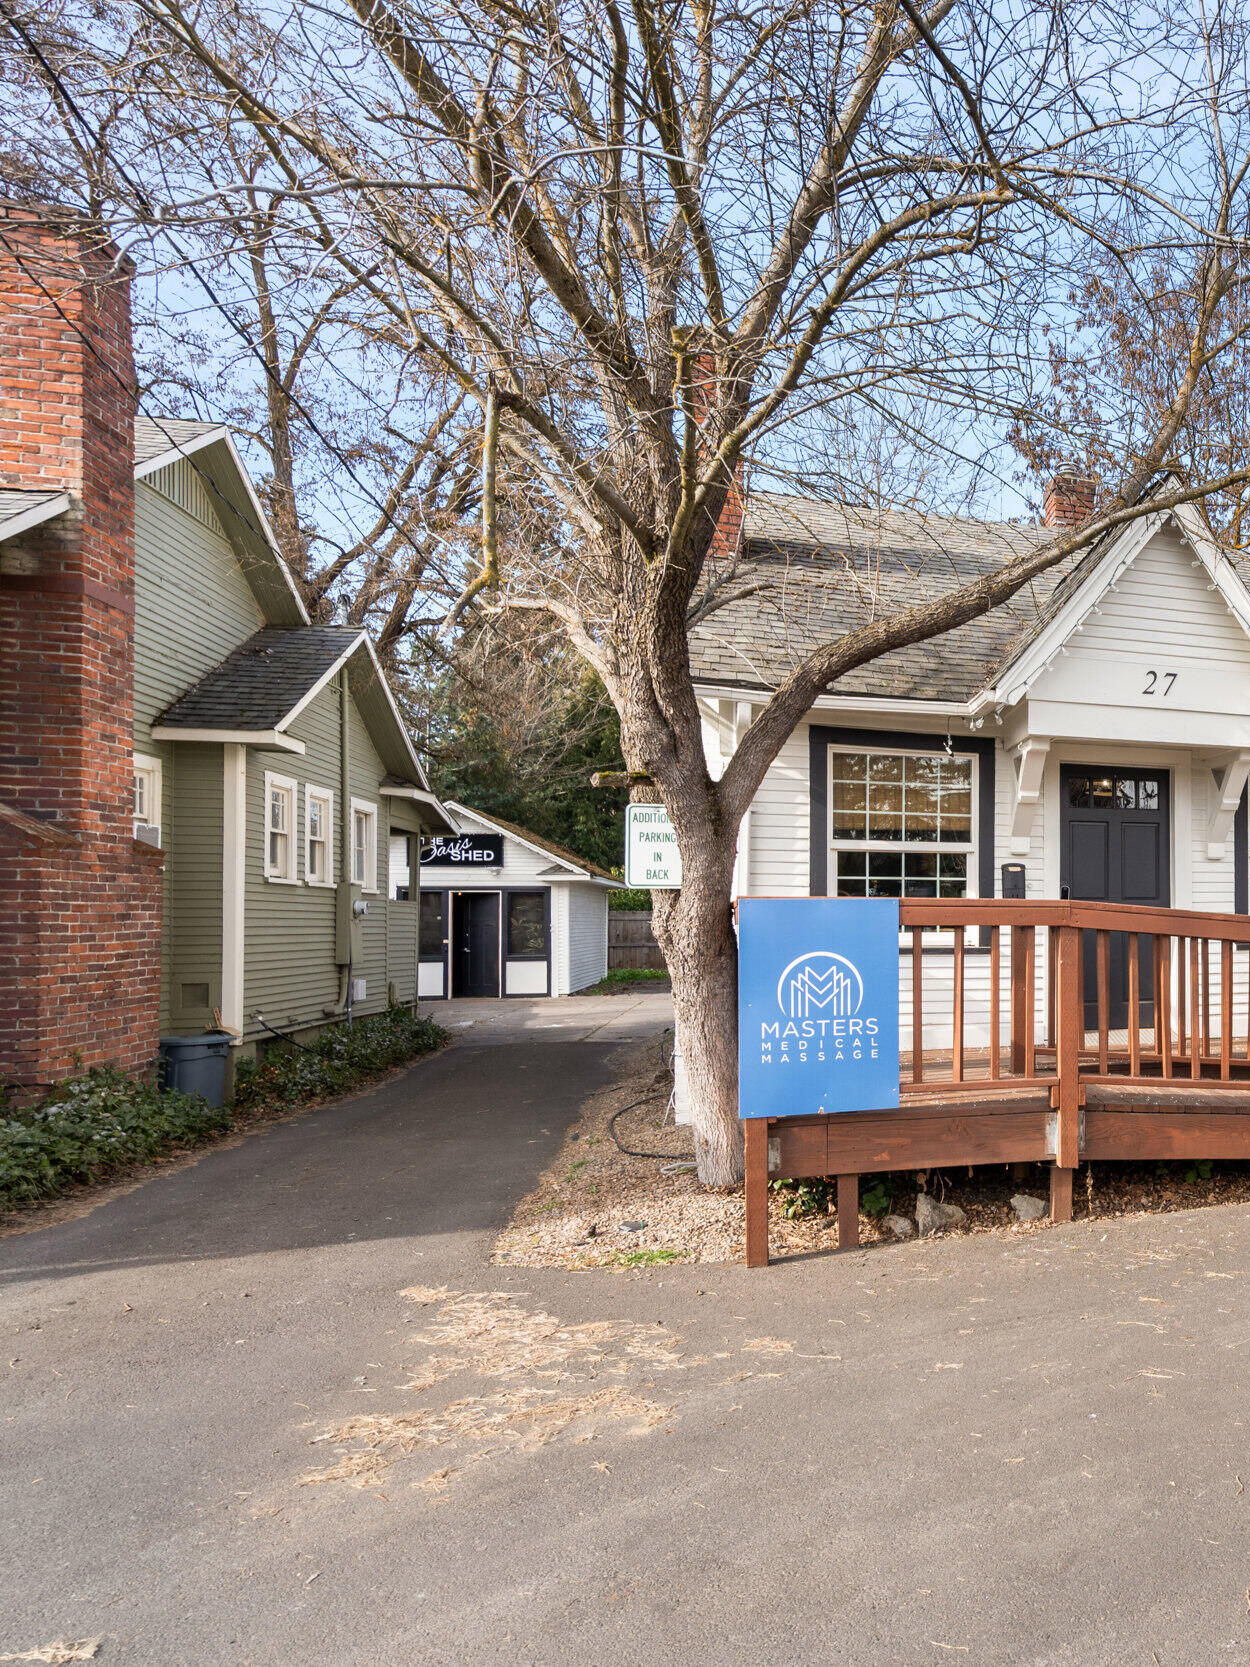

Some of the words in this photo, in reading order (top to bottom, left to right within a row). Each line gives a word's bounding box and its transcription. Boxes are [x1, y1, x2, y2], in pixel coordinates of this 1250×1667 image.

[1142, 670, 1178, 697] 27
[639, 831, 677, 843] PARKING
[450, 850, 495, 861] SHED
[653, 852, 662, 862] IN
[646, 869, 669, 879] BACK
[761, 1018, 879, 1040] MASTERS
[761, 1037, 879, 1052] MEDICAL
[761, 1049, 879, 1064] MASSAGE
